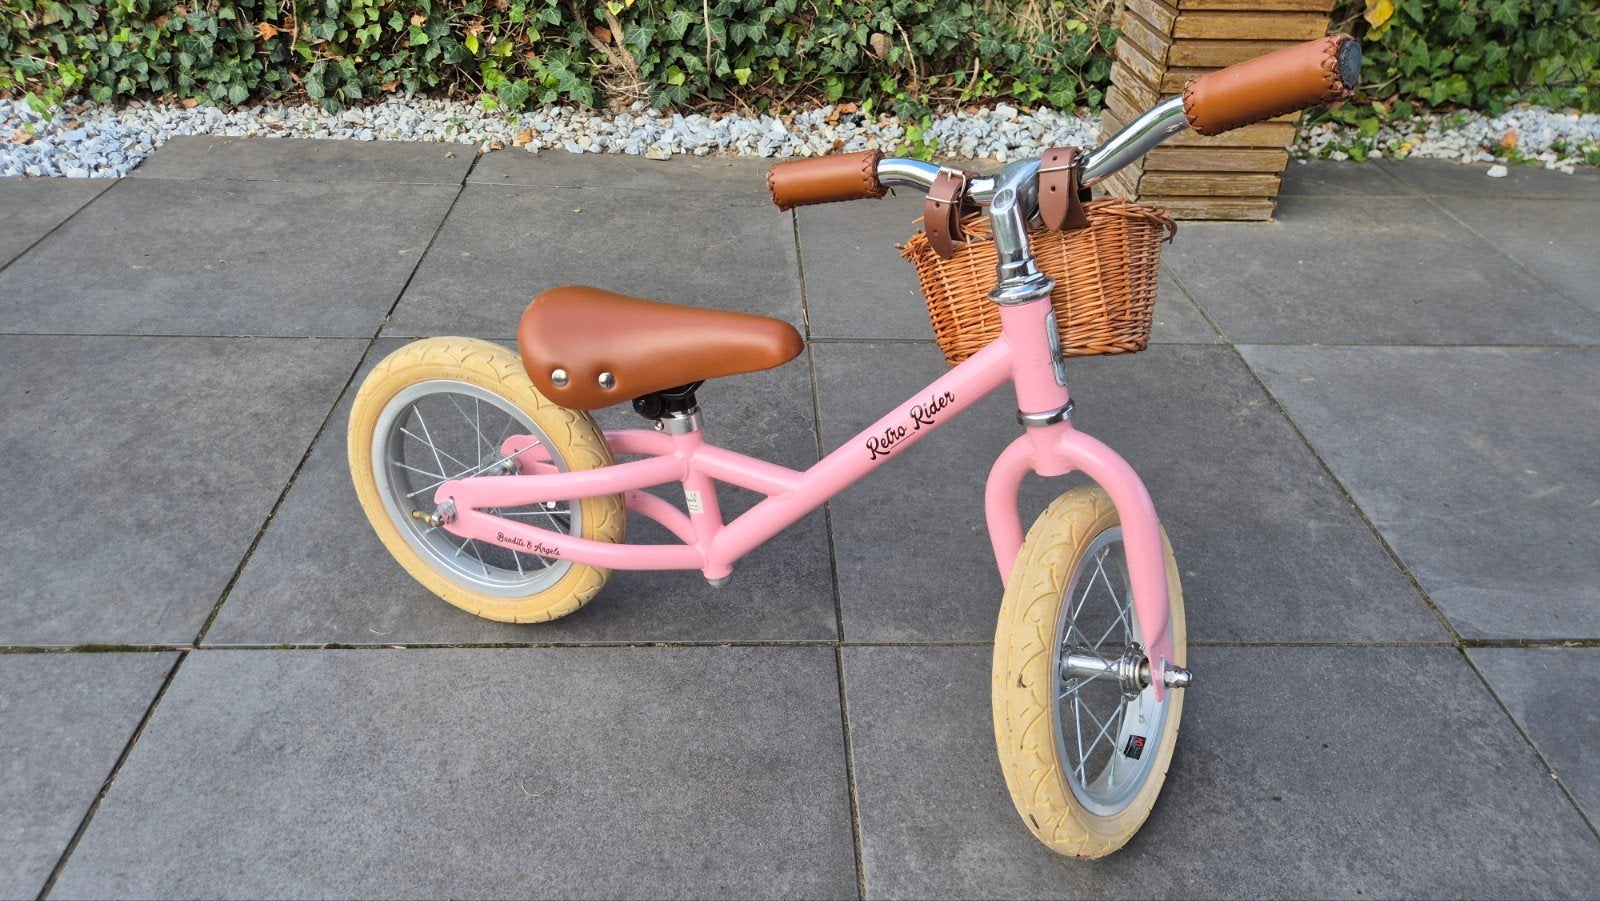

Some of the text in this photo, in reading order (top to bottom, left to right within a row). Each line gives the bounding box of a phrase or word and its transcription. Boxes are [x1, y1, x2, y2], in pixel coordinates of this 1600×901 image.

[866, 391, 955, 460] Retro Rider
[497, 532, 560, 556] Bandits & Angels
